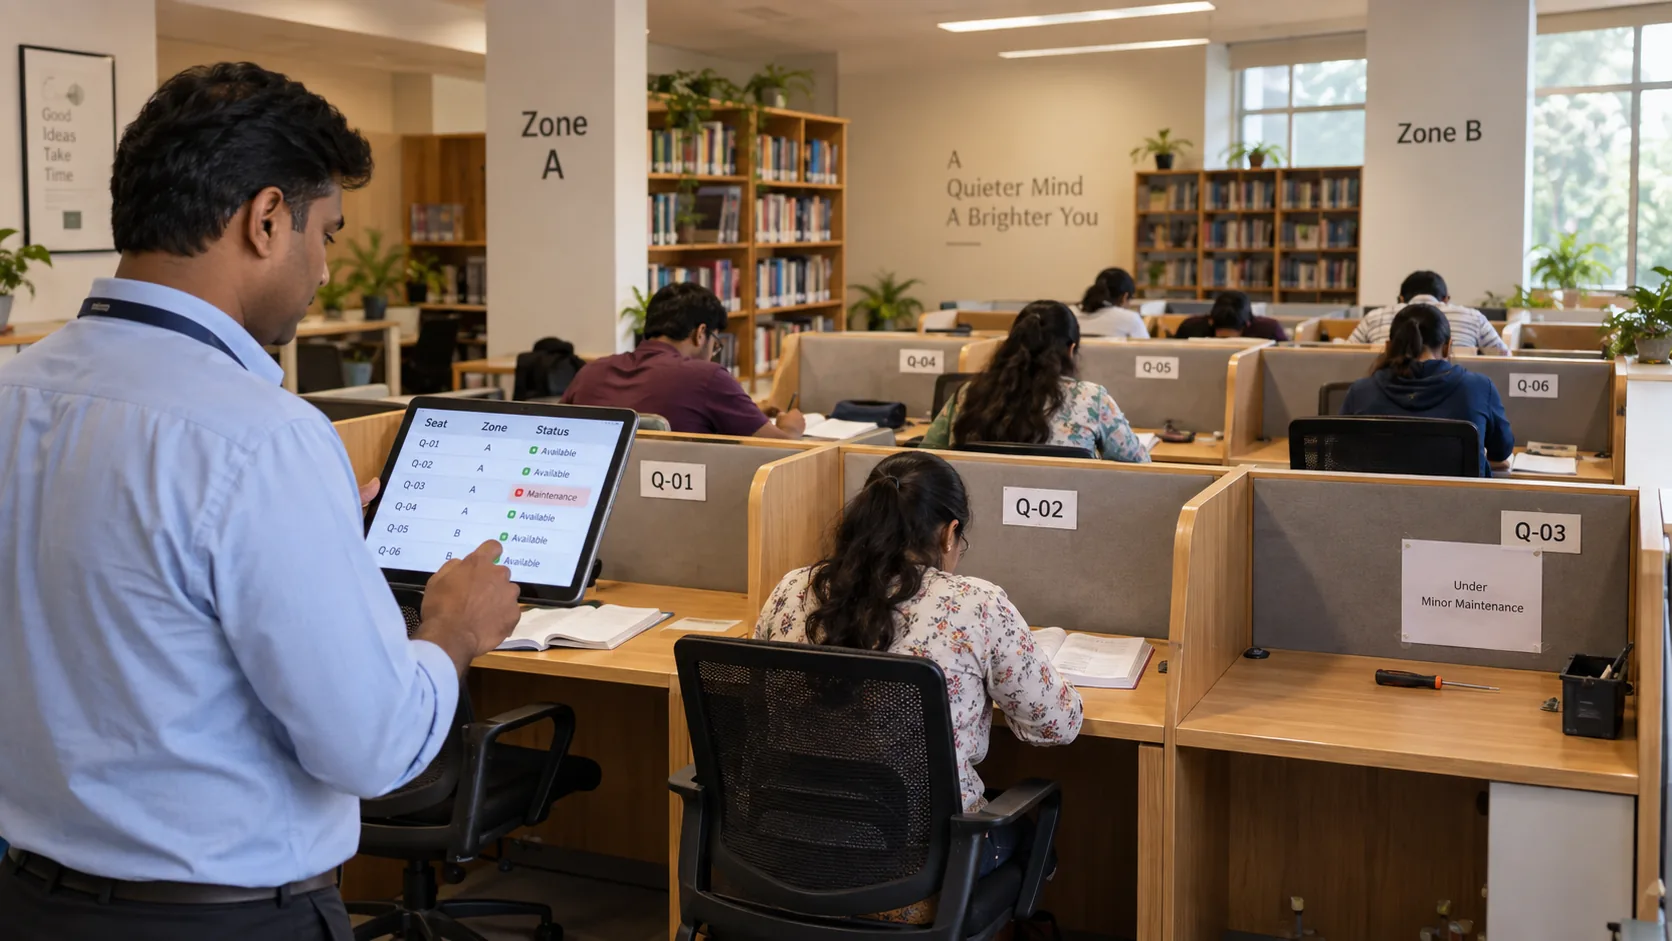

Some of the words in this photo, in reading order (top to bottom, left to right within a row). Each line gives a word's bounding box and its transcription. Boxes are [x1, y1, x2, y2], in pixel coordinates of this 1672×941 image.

[42, 107, 72, 122] Good
[521, 110, 588, 138] Zone
[42, 127, 76, 143] Ideas
[1397, 122, 1456, 144] Zone
[1465, 119, 1482, 142] B
[44, 147, 72, 162] Take
[541, 148, 565, 180] A
[947, 150, 962, 170] A
[45, 167, 74, 182] Time
[946, 177, 1024, 201] Quieter
[1031, 175, 1083, 197] Mind
[946, 207, 961, 227] A
[968, 205, 1052, 232] Brighter
[1059, 206, 1099, 227] You
[907, 356, 936, 369] Q-04
[1142, 361, 1172, 374] Q-05
[1517, 379, 1549, 393] Q-06
[424, 417, 448, 429] Seat
[481, 421, 508, 433] Zone
[536, 425, 570, 437] Status
[419, 438, 440, 449] Q-01
[484, 443, 492, 452] A
[540, 447, 577, 458] Available
[411, 459, 434, 470] Q-02
[476, 464, 485, 473] A
[533, 468, 570, 479] Available
[651, 470, 694, 491] Q-01
[403, 480, 426, 491] Q-03
[468, 485, 477, 494] A
[526, 489, 578, 502] Maintenance
[395, 502, 418, 513] Q-04
[460, 507, 469, 516] A
[519, 511, 556, 523] Available
[1016, 497, 1064, 519] Q-02
[386, 523, 409, 535] Q-05
[453, 528, 462, 538] B
[511, 533, 549, 545] Available
[1515, 521, 1567, 543] Q-03
[377, 545, 402, 557] Q-06
[445, 551, 453, 561] B
[503, 555, 541, 568] Available
[1454, 580, 1489, 592] Under
[1421, 596, 1453, 608] Minor
[1455, 598, 1525, 613] Maintenance
